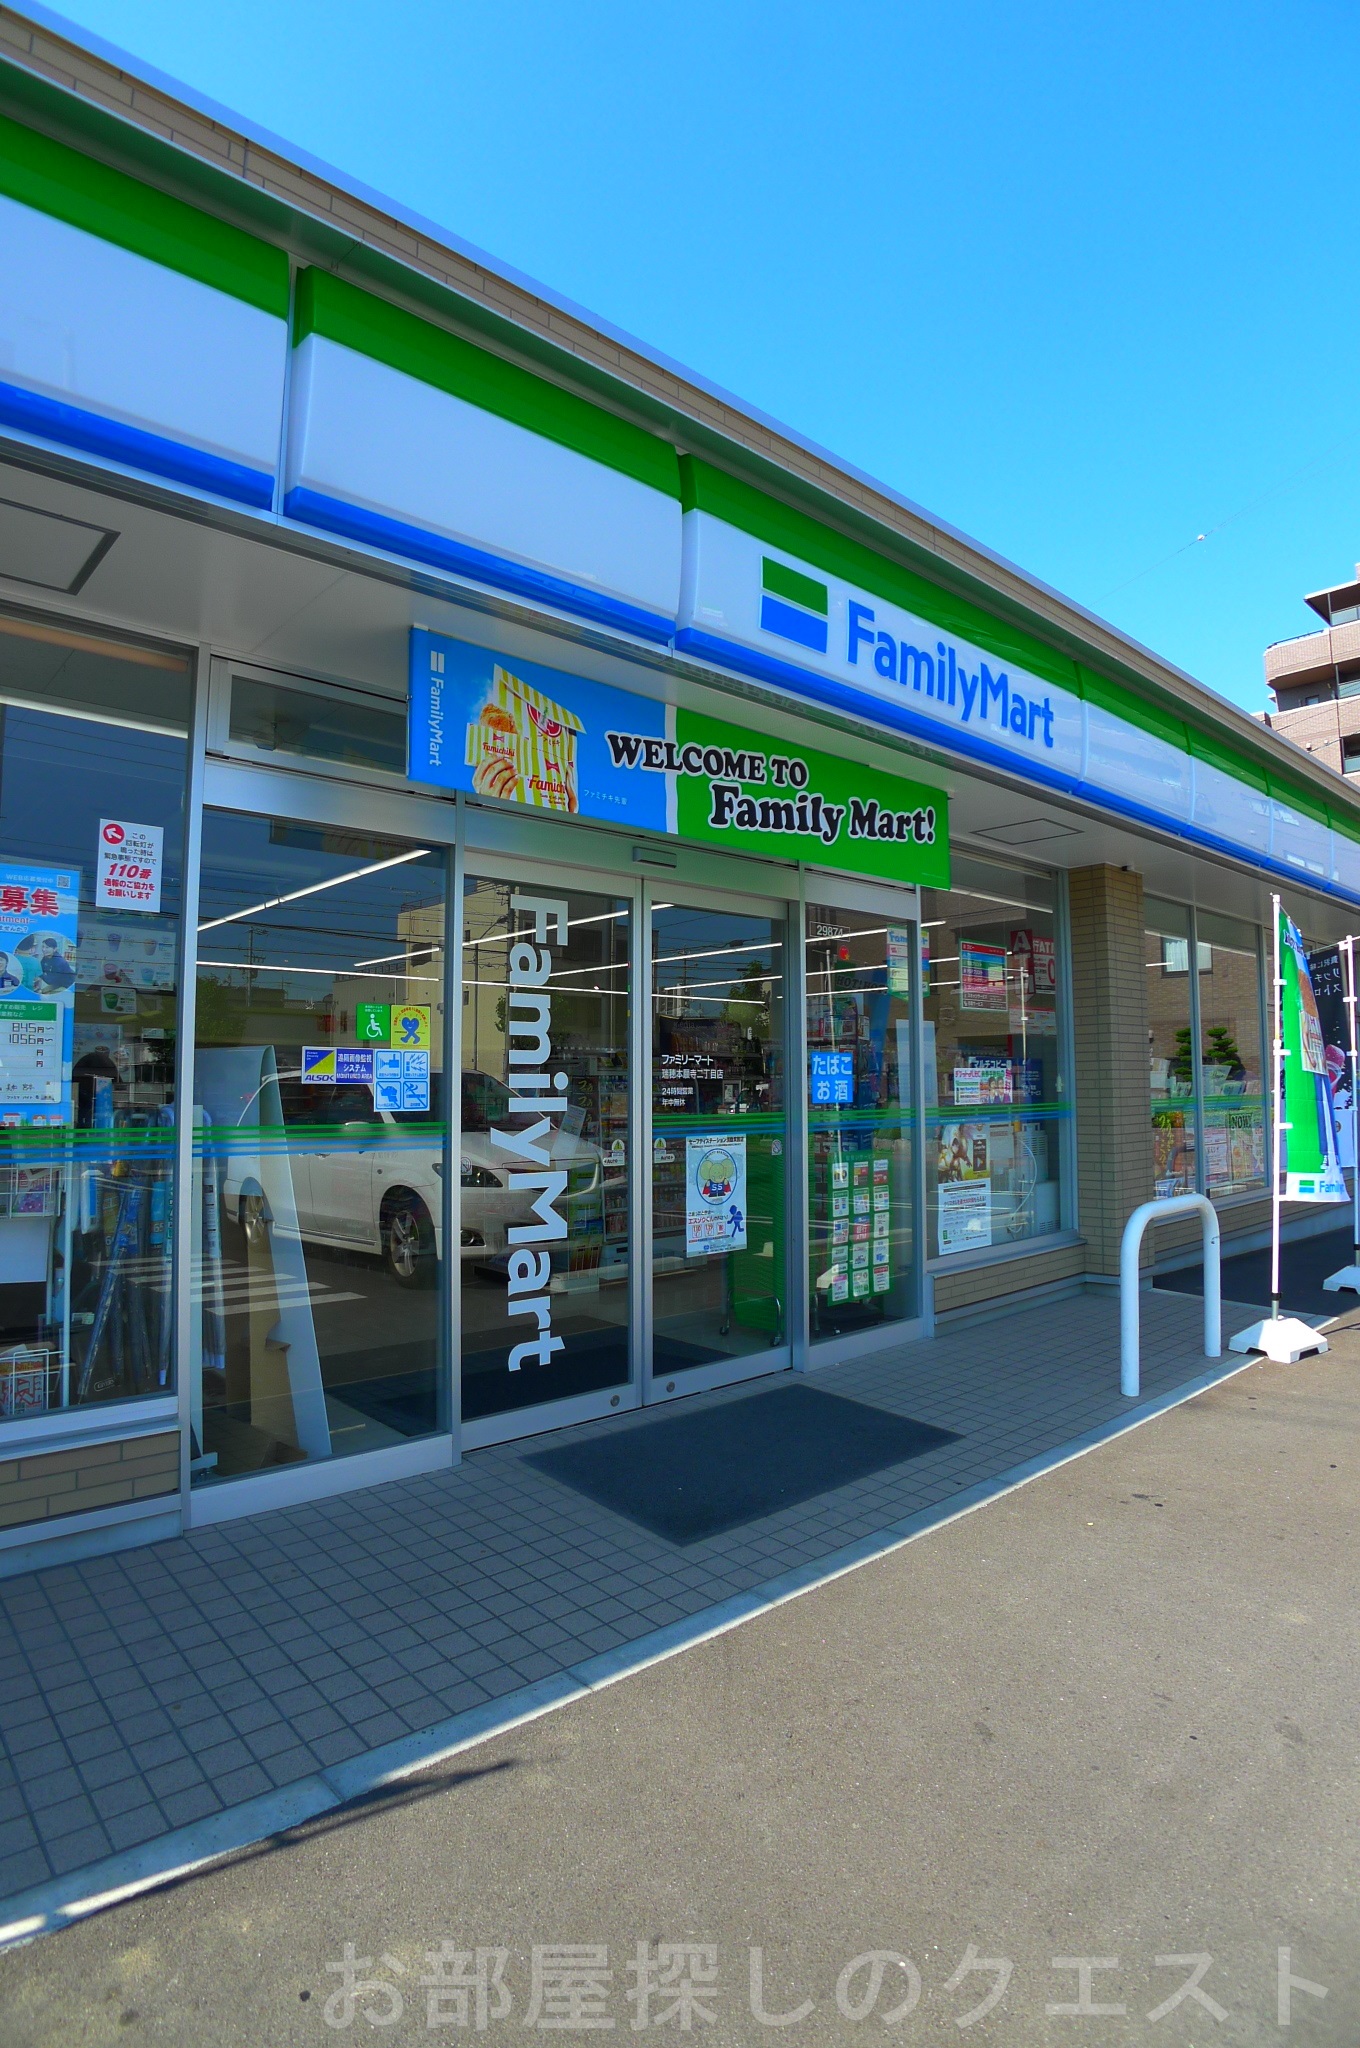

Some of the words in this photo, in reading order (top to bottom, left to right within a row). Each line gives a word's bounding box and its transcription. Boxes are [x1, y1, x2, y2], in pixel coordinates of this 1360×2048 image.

[848, 599, 1054, 748] FamilyMart
[428, 677, 445, 766] FamilyMart
[606, 733, 766, 783] WELCOME
[771, 758, 808, 787] TO
[710, 783, 845, 843] Family
[849, 799, 935, 843] Mart!
[132, 832, 146, 840] この
[125, 839, 154, 849] 回転灯が
[108, 863, 153, 879] 110番
[103, 878, 155, 891] 通報のご協力を
[0, 884, 59, 916] 募集
[107, 888, 152, 900] お願いします
[816, 924, 844, 937] 29874
[661, 1054, 714, 1066] ファミリーマート
[813, 1055, 853, 1075] たばこ
[343, 1064, 367, 1073] システム
[305, 1074, 335, 1082] ALSOK
[661, 1087, 694, 1096] 24時間営業
[817, 1080, 848, 1101] お酒
[490, 893, 569, 1372] FamilyMart
